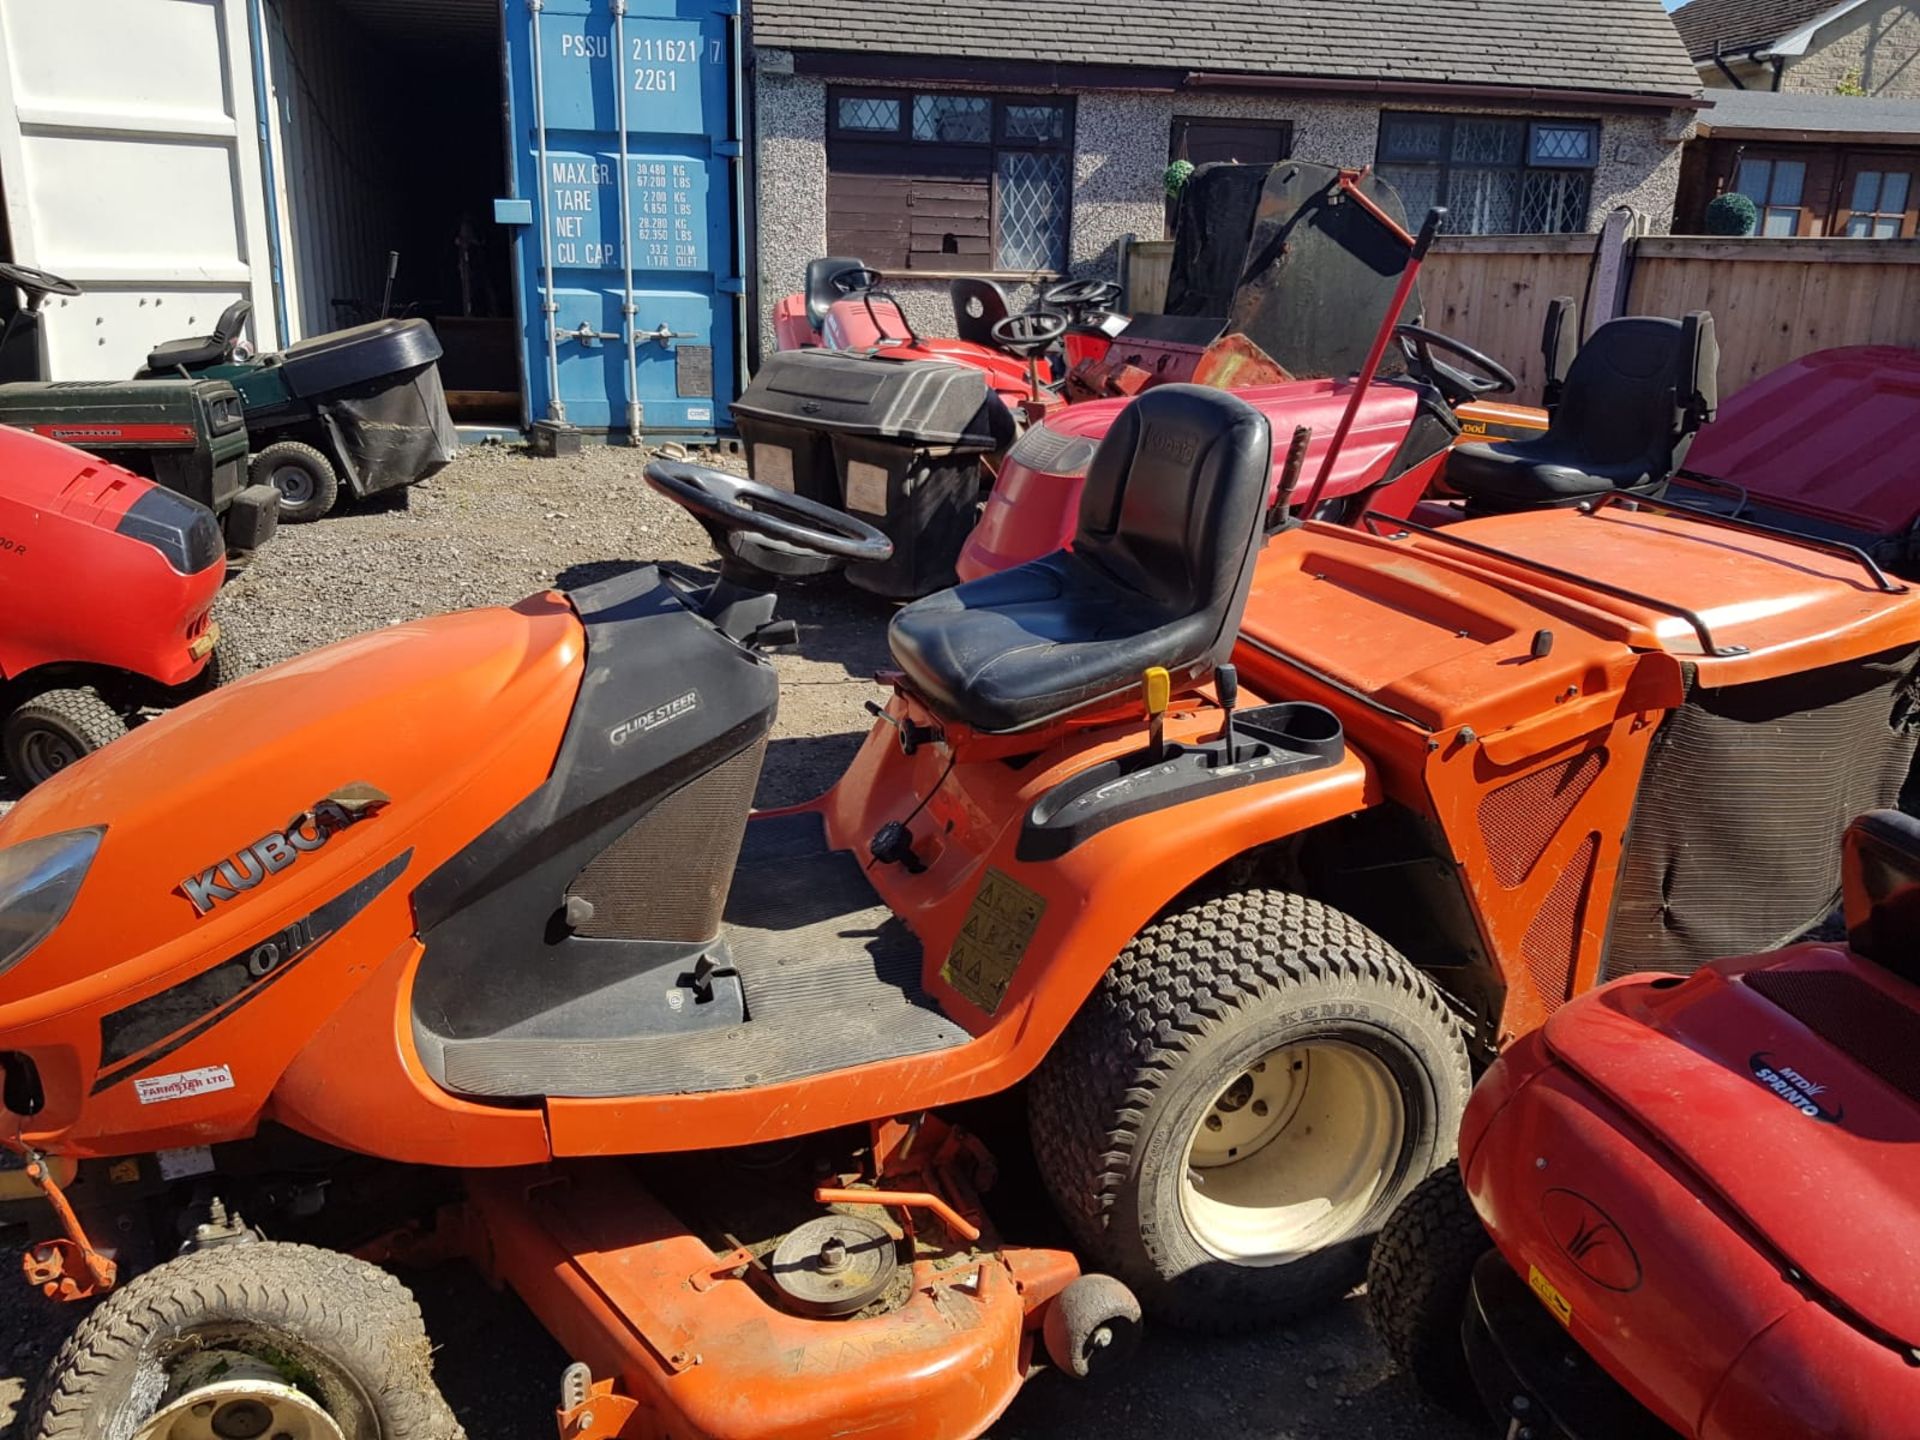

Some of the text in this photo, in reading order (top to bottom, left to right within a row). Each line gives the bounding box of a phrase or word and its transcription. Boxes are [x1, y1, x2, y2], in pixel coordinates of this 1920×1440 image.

[562, 34, 607, 58] PSSU
[632, 38, 696, 62] 211621
[634, 68, 676, 92] 22G1
[672, 164, 685, 176] KG
[673, 177, 691, 188] LBS
[555, 190, 592, 211] TARE
[673, 192, 686, 203] KG
[674, 203, 692, 215] LBS
[556, 216, 583, 238] NET
[675, 218, 688, 230] KG
[675, 230, 692, 241] LBS
[558, 243, 617, 265] CU. CAP.
[14, 544, 26, 556] R
[1278, 1003, 1370, 1026] KENDA
[1779, 1066, 1811, 1090] MTD
[143, 1079, 203, 1097] FARMSTAR
[1755, 1068, 1819, 1117] SPRINTO
